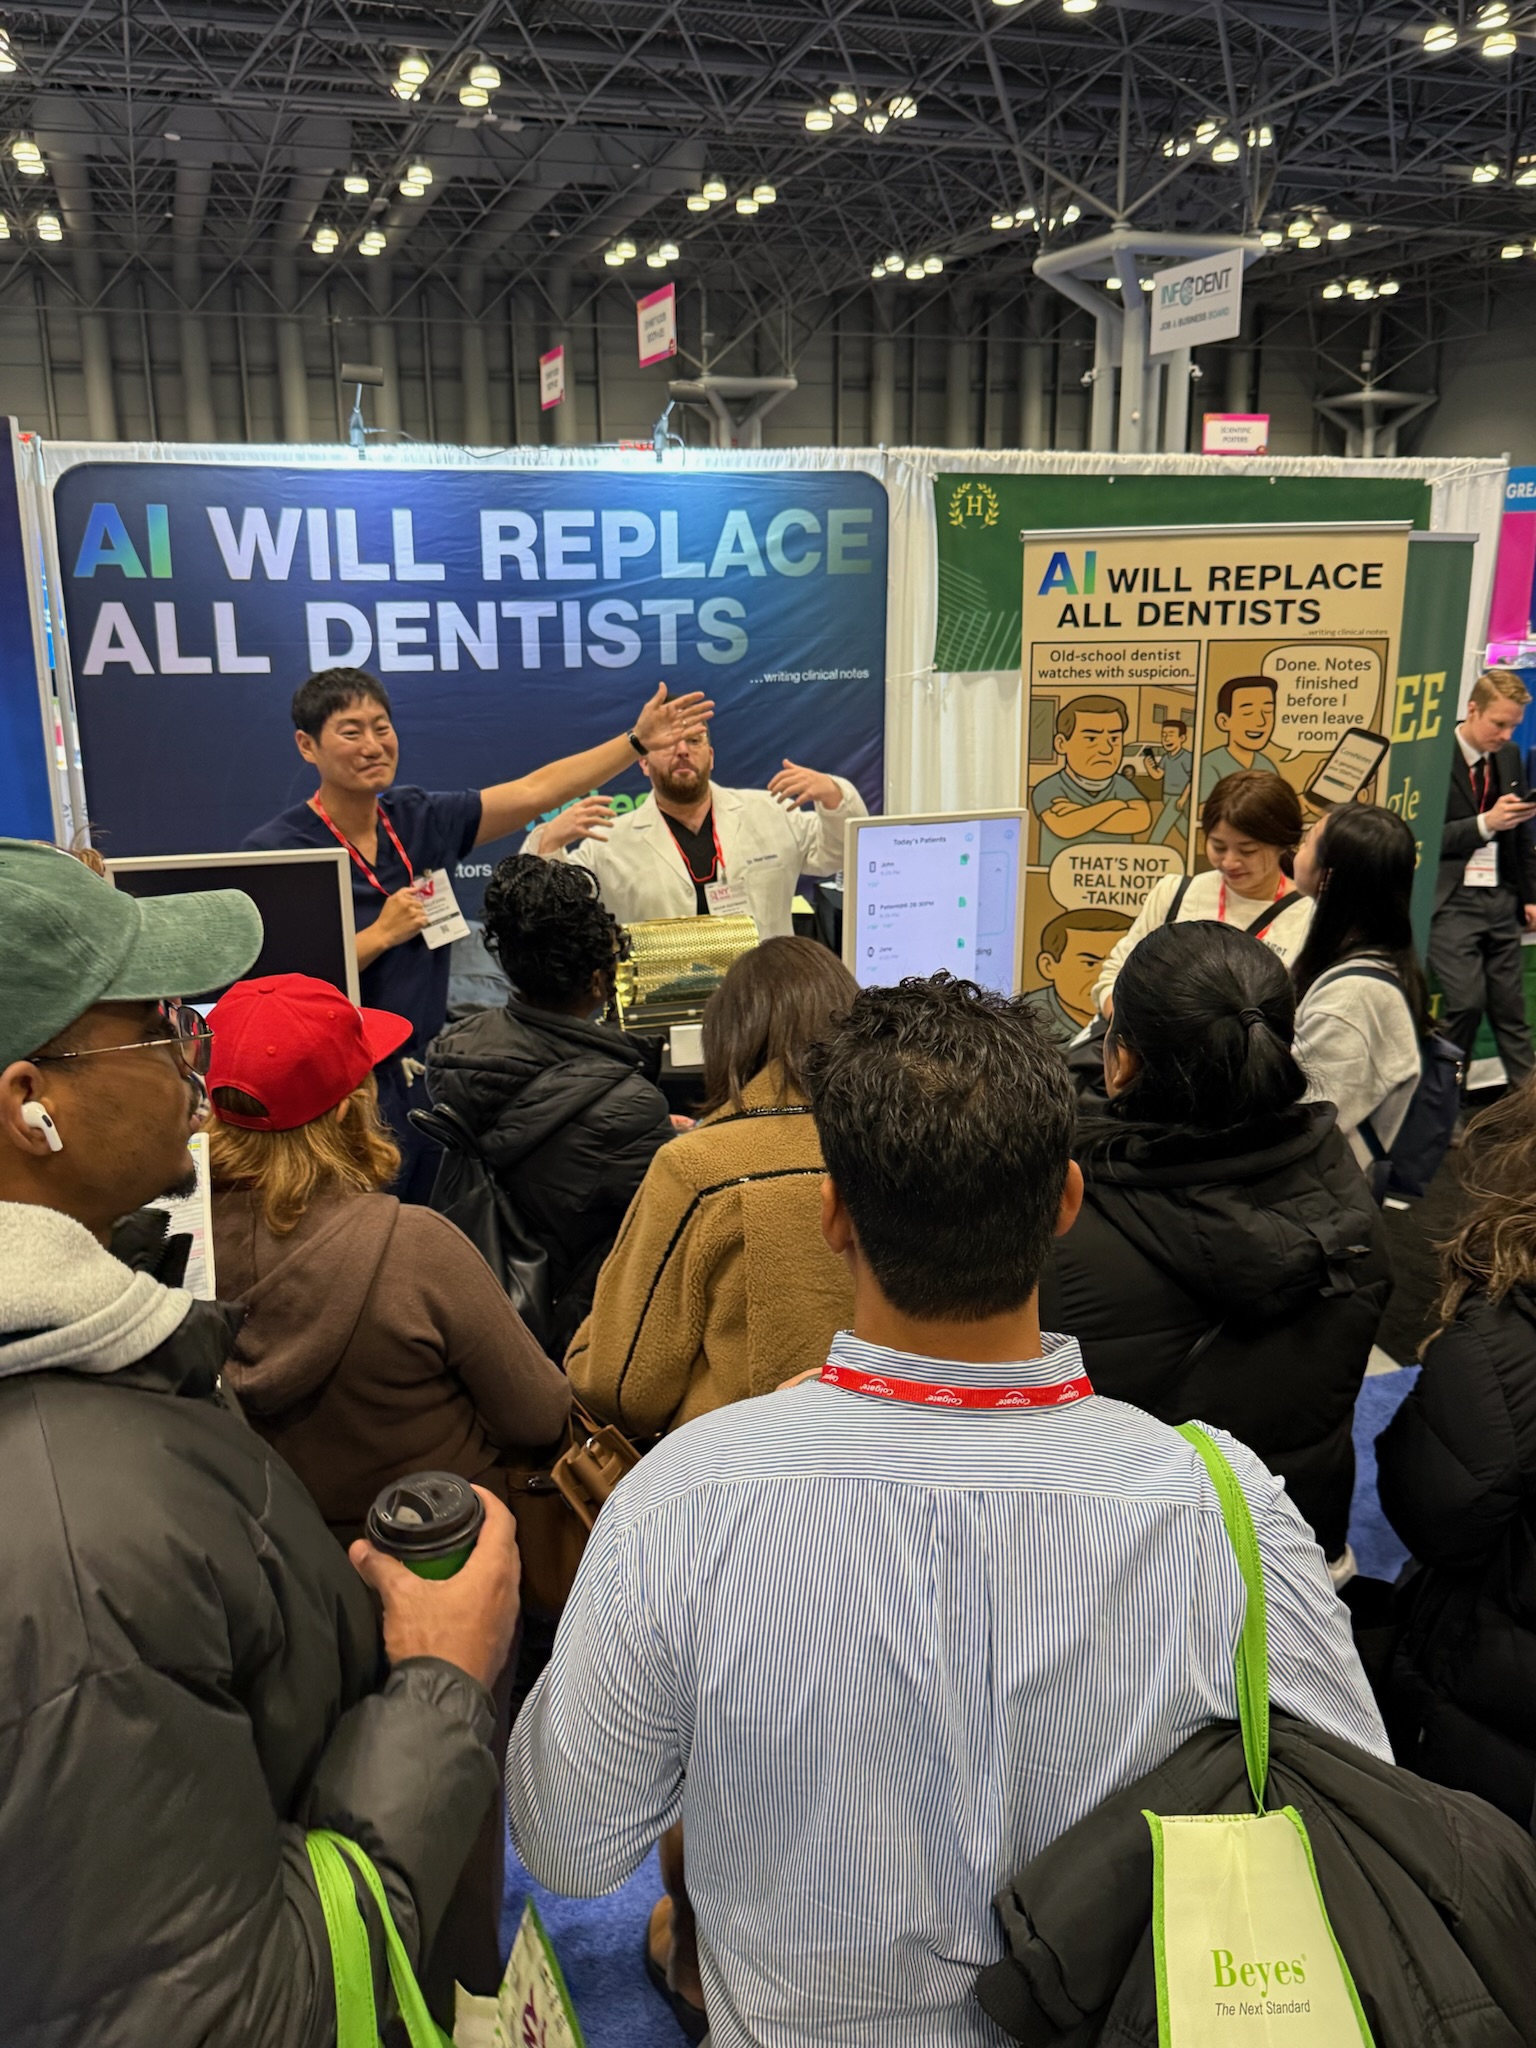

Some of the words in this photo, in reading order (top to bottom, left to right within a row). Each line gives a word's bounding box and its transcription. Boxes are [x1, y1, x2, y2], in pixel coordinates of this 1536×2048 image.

[1506, 482, 1536, 498] GRE
[965, 495, 983, 516] H
[73, 502, 173, 579] AI
[206, 505, 446, 581] WILL
[479, 508, 873, 581] REPLACE
[1038, 551, 1097, 595] AI
[1107, 566, 1192, 593] WILL
[1208, 562, 1384, 592] REPLACE
[1057, 602, 1122, 628] ALL
[1137, 598, 1321, 627] DENTISTS
[82, 600, 271, 675] ALL
[304, 597, 749, 674] DENTISTS
[1337, 628, 1364, 636] clinical
[1366, 628, 1388, 636] notes
[1050, 649, 1126, 662] Old-school
[1131, 649, 1181, 661] dentist
[1038, 667, 1091, 679] watches
[1096, 665, 1124, 678] with
[1275, 657, 1320, 672] Done.
[1325, 657, 1372, 671] Notes
[801, 668, 838, 681] clinical
[840, 668, 870, 680] notes
[1295, 676, 1359, 690] finished
[1287, 693, 1338, 707] before
[1343, 694, 1347, 707] I
[1281, 714, 1318, 725] even
[1323, 711, 1364, 724] leave
[1298, 731, 1338, 741] room
[893, 837, 919, 847] Today's
[920, 836, 946, 844] Patients
[455, 863, 493, 879] tors
[1069, 856, 1128, 871] THAT'S
[1133, 858, 1170, 872] NOT
[1073, 874, 1116, 888] REAL
[860, 1383, 894, 1396] Colgate
[926, 1394, 963, 1406] Colgate
[996, 1398, 1031, 1406] Colgate
[1216, 2002, 1236, 2016] The
[1239, 2001, 1263, 2016] Next
[1266, 2000, 1311, 2014] Standard
